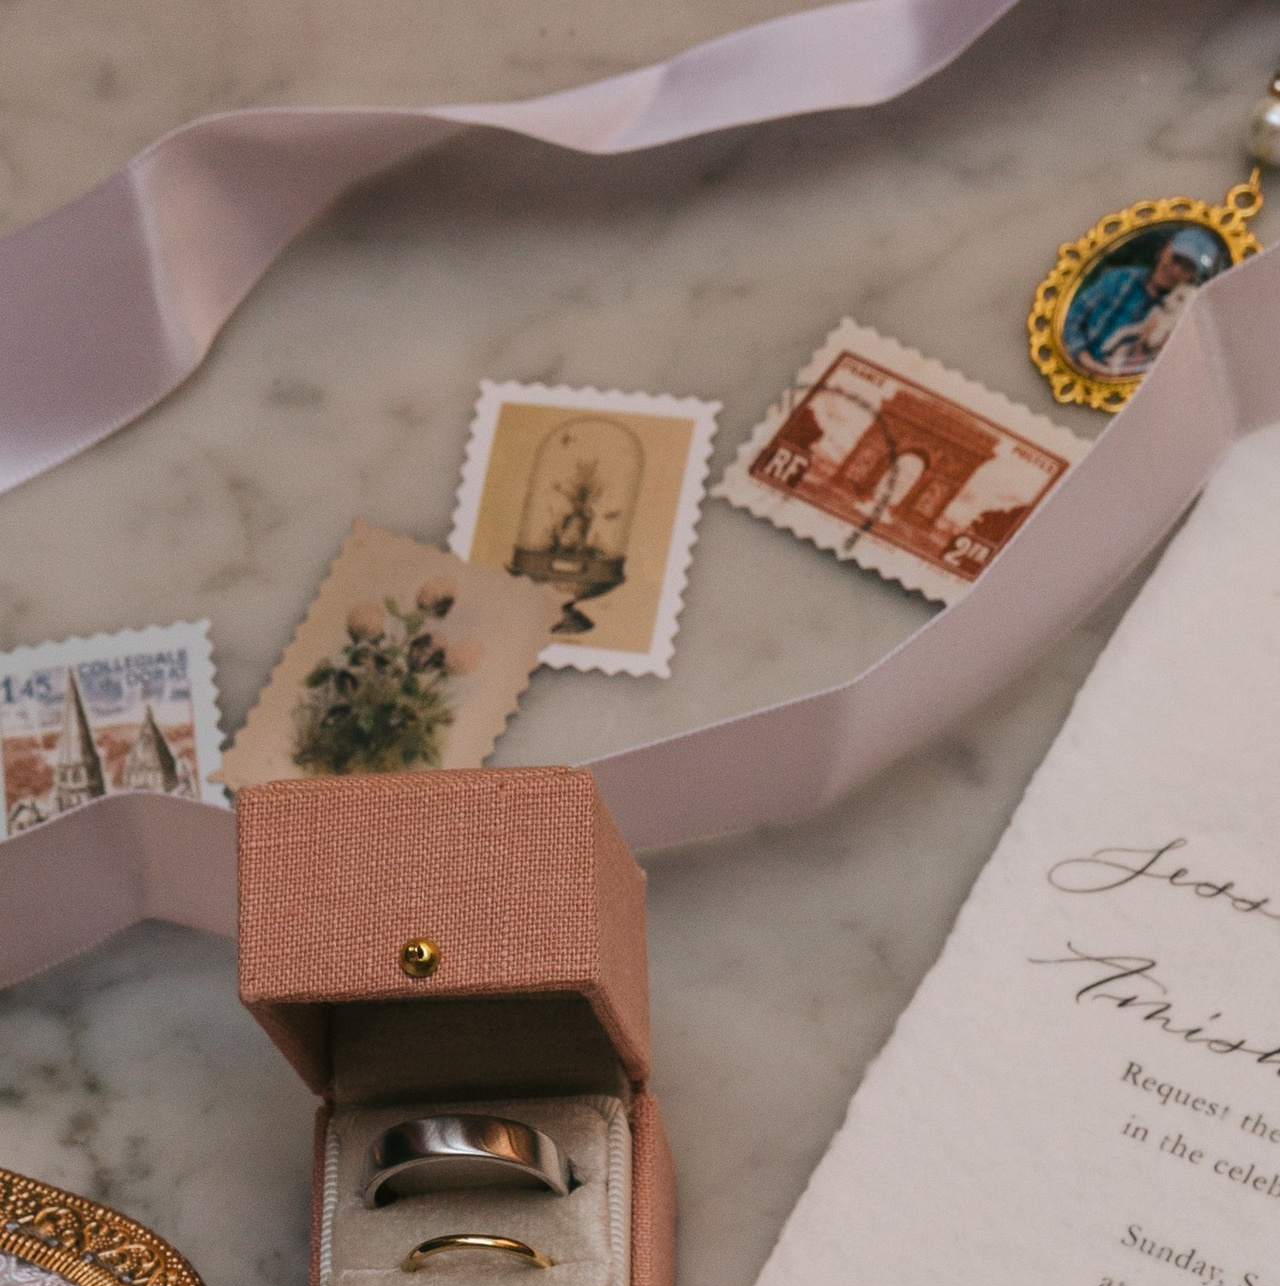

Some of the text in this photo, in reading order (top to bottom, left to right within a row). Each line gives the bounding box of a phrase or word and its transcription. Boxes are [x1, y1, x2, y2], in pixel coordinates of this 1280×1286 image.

[763, 447, 808, 483] RF
[1120, 1061, 1231, 1121] Request
[1121, 1114, 1149, 1142] in
[1159, 1134, 1204, 1165] the
